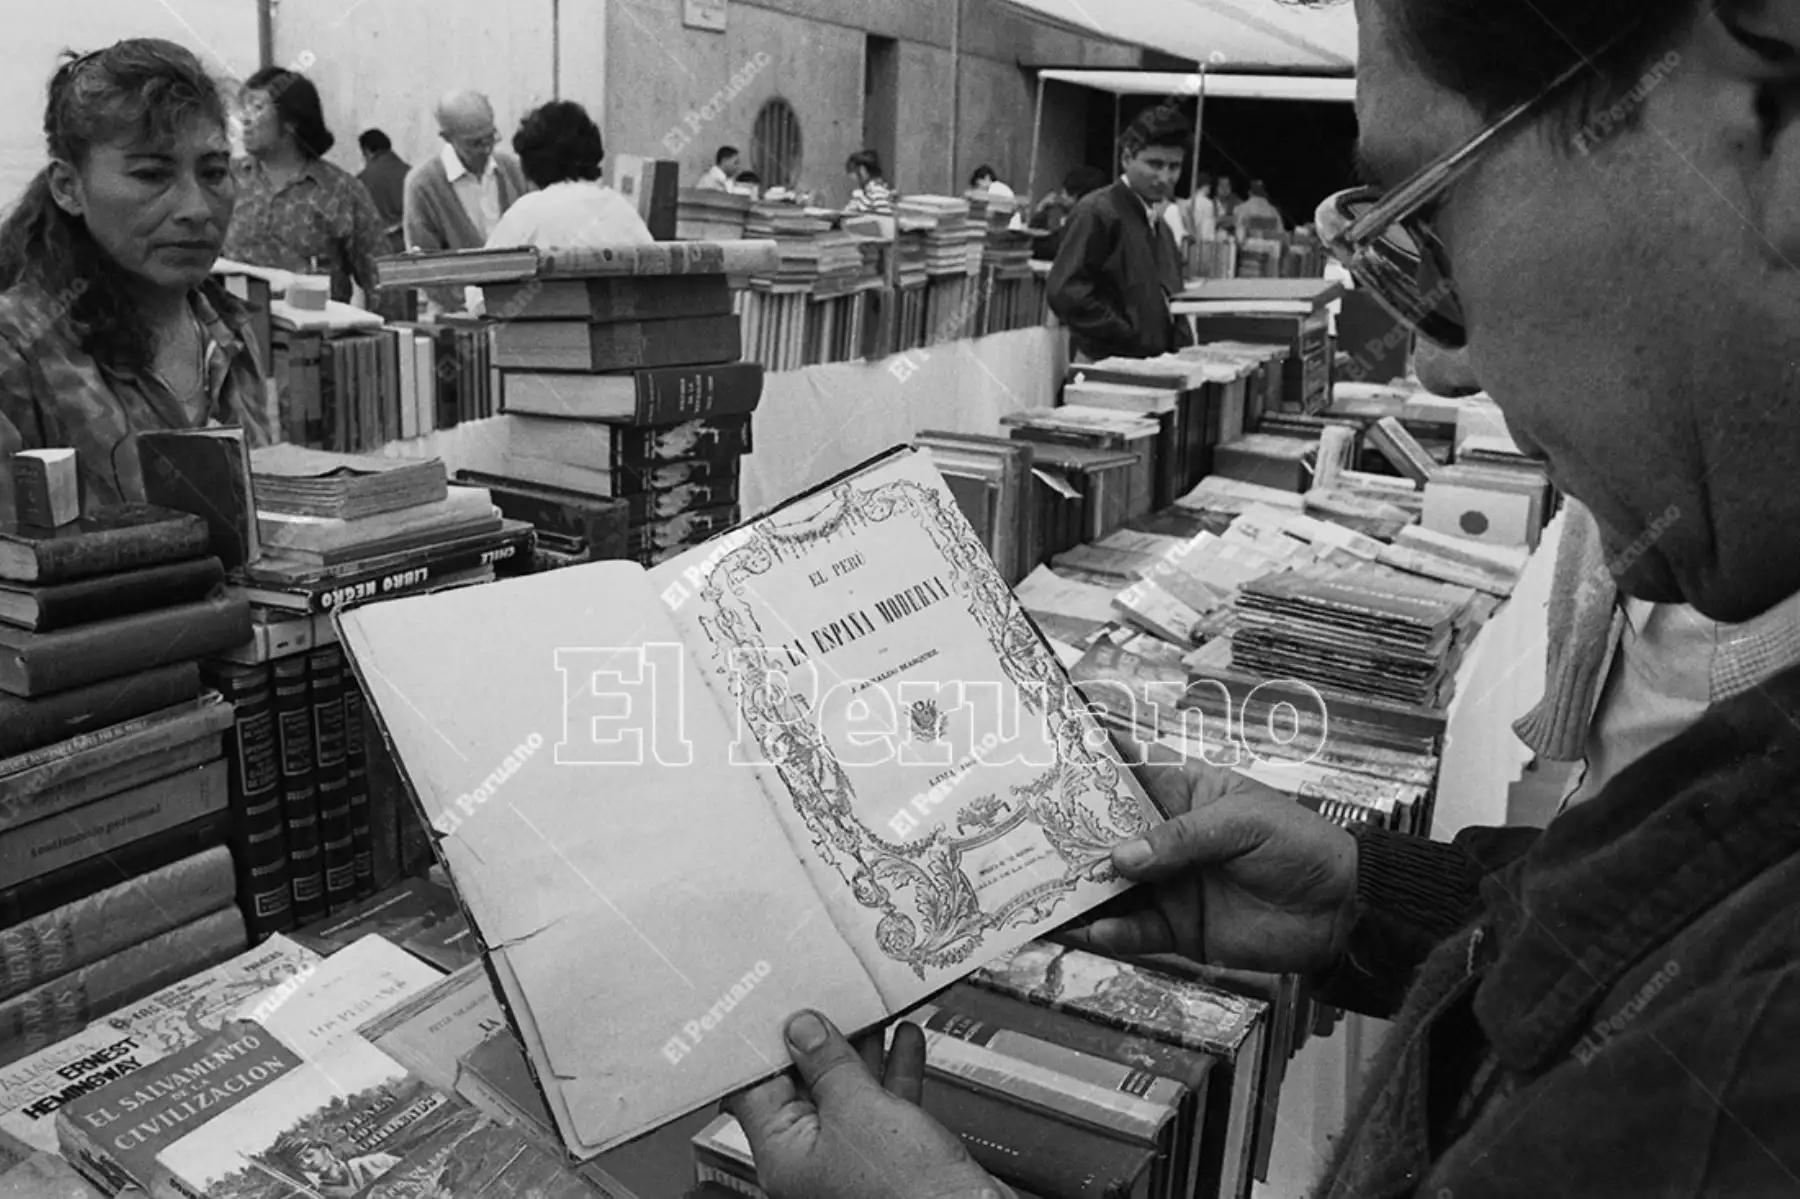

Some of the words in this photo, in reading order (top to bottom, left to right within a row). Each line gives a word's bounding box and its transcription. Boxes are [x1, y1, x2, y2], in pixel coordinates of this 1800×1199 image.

[321, 580, 376, 607] NEGRO
[383, 567, 428, 592] LIBRO
[808, 570, 828, 588] EL
[57, 1037, 139, 1081] ERNEST
[22, 1056, 143, 1121] HEMINGWAY
[84, 1106, 120, 1128] EL
[119, 1035, 261, 1112] SALVAMENTO
[114, 1055, 285, 1151] CIVILIZACION
